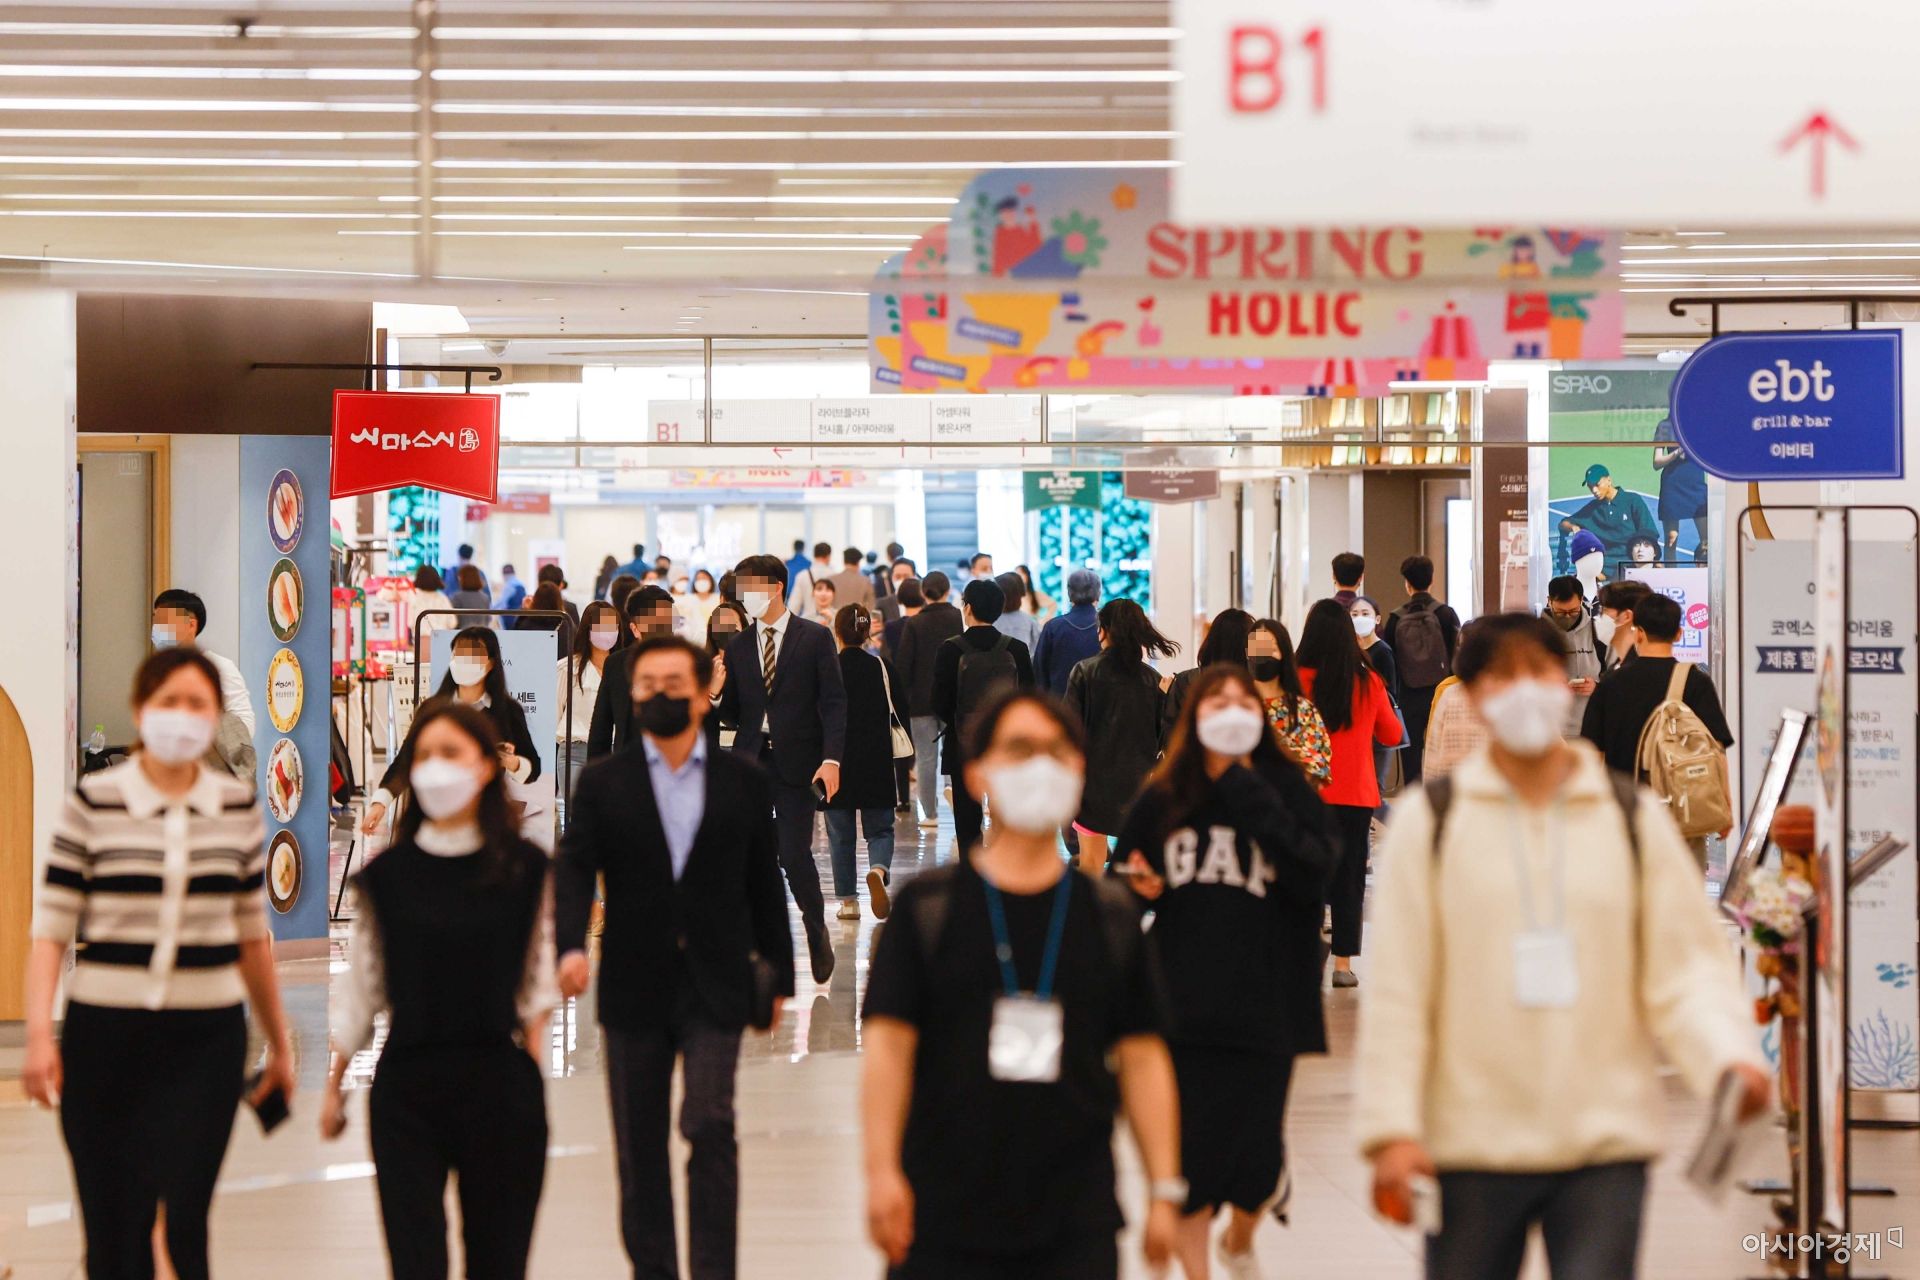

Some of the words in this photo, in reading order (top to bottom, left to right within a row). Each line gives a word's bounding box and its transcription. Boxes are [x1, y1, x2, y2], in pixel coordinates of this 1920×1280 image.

[1228, 25, 1329, 114] B1
[1146, 222, 1425, 282] SPRING
[1207, 291, 1362, 338] HOLIC
[1552, 375, 1612, 394] SPAO
[1749, 358, 1835, 403] ebt
[657, 422, 681, 442] B1
[1752, 415, 1787, 431] grill
[1790, 416, 1802, 428] &
[1806, 415, 1832, 428] bar
[1769, 442, 1814, 459] 이비티
[1771, 620, 1815, 636] 코엑스
[1766, 651, 1797, 669] 제휴
[1851, 651, 1895, 670] 로모션
